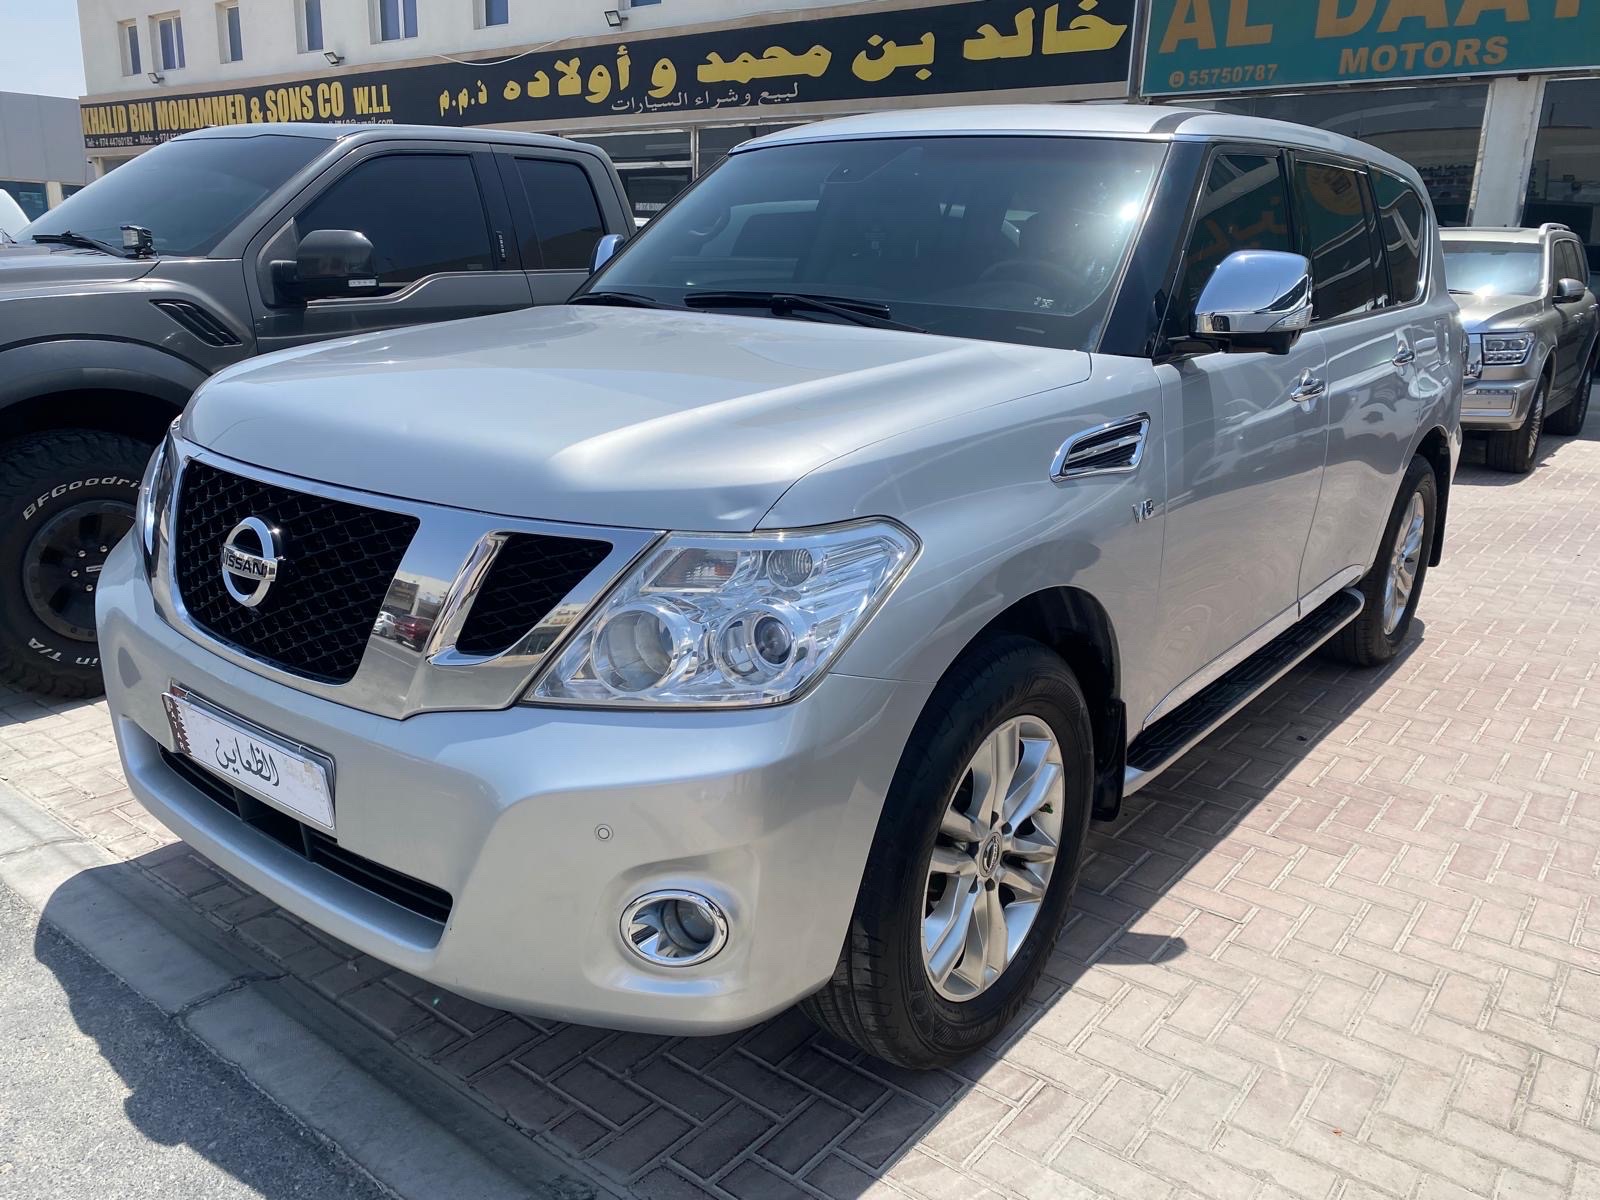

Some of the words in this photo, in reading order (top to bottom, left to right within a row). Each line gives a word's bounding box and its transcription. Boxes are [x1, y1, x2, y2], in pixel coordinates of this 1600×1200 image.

[961, 0, 1128, 60] خالد
[1159, 0, 1273, 53] AL
[503, 45, 631, 104] أولاده
[697, 45, 832, 83] محمد
[851, 32, 936, 81] بن
[1188, 63, 1278, 86] 55750787
[1338, 36, 1509, 75] MOTORS
[648, 58, 677, 98] و
[757, 82, 799, 106] لبيع
[81, 106, 127, 135] KHALID
[128, 102, 154, 133] BIN
[155, 94, 246, 131] MOHAMMED
[250, 97, 263, 124] &
[265, 85, 314, 123] SONS
[317, 81, 344, 118] CO
[611, 92, 688, 114] السيارات
[224, 547, 269, 578] NISSAN
